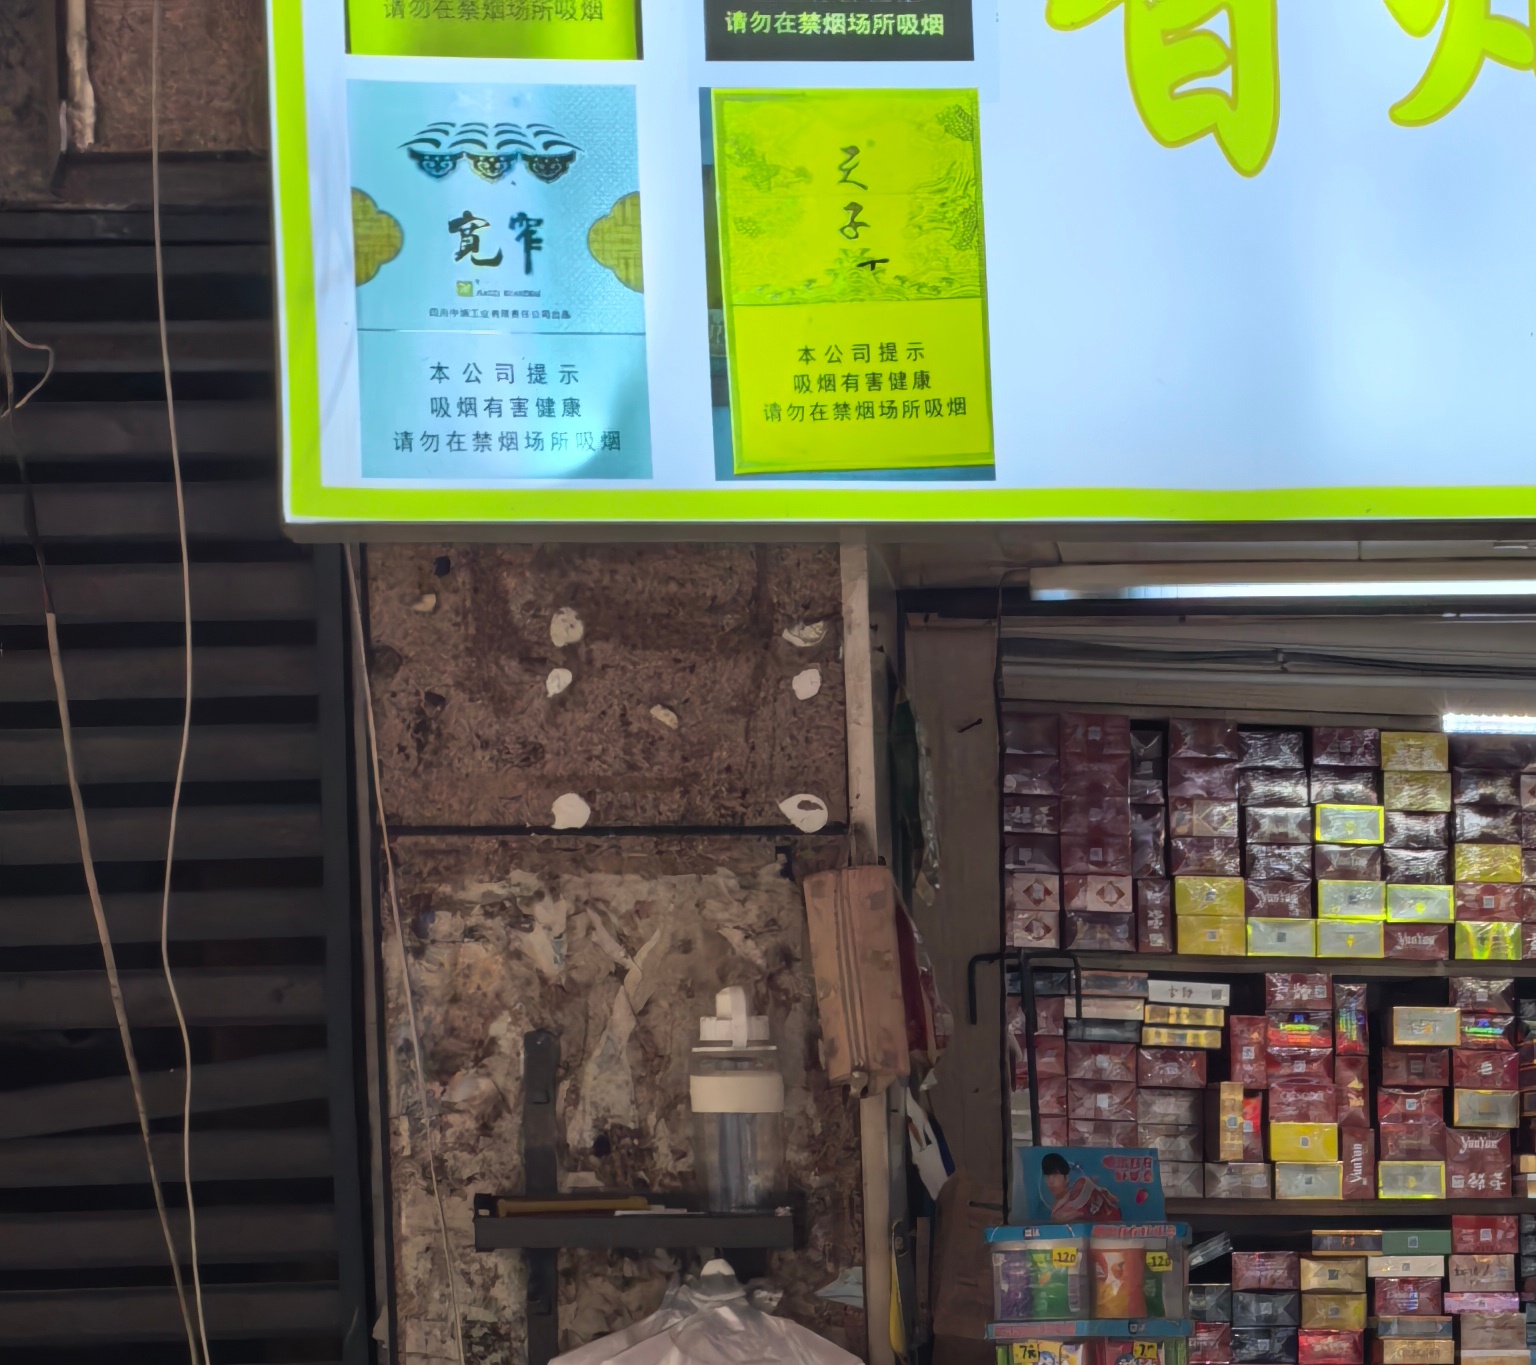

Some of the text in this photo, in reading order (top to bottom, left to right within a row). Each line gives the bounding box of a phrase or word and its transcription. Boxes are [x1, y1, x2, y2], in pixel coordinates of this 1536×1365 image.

[725, 10, 944, 35] 请勿在禁烟场所吸烟
[798, 342, 925, 365] 本公司提示
[429, 362, 579, 385] 本公司提示
[794, 370, 931, 393] 吸烟有害健康
[429, 396, 582, 418] 吸烟有害健康
[763, 396, 967, 422] 请勿在禁烟场所吸烟
[393, 430, 621, 453] 请勿在禁烟场所吸烟
